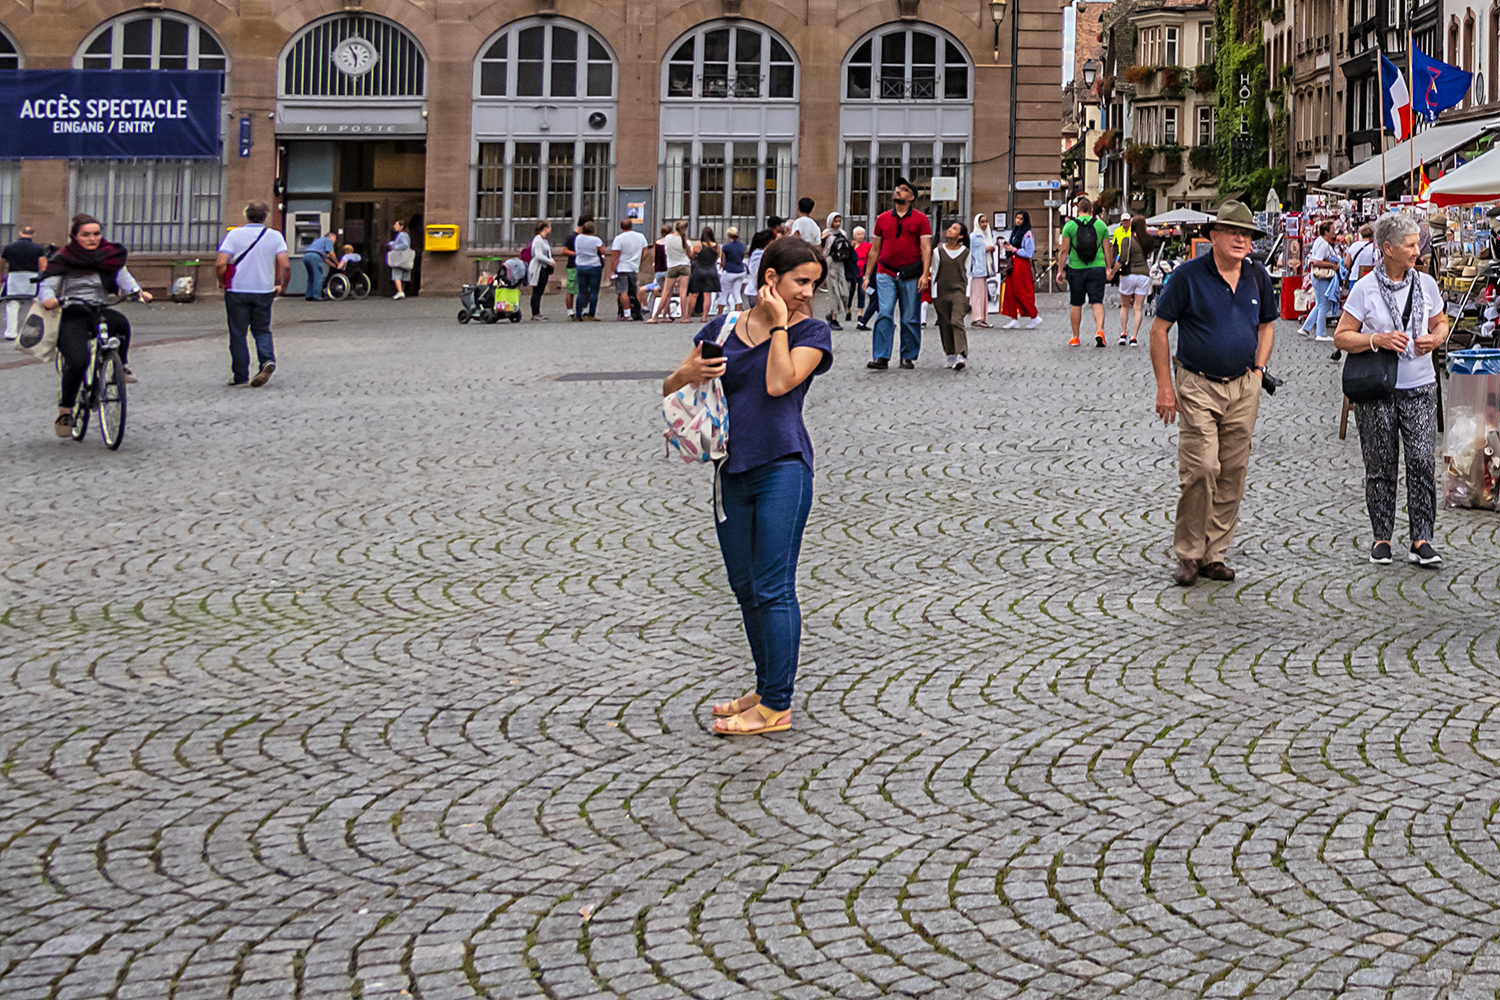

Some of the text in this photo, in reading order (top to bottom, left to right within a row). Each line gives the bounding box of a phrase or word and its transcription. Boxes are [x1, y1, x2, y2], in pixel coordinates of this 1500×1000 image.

[20, 93, 188, 119] ACCÈS SPECTACLE
[53, 120, 156, 133] EINGANG / ENTRY
[339, 125, 397, 133] POSTE
